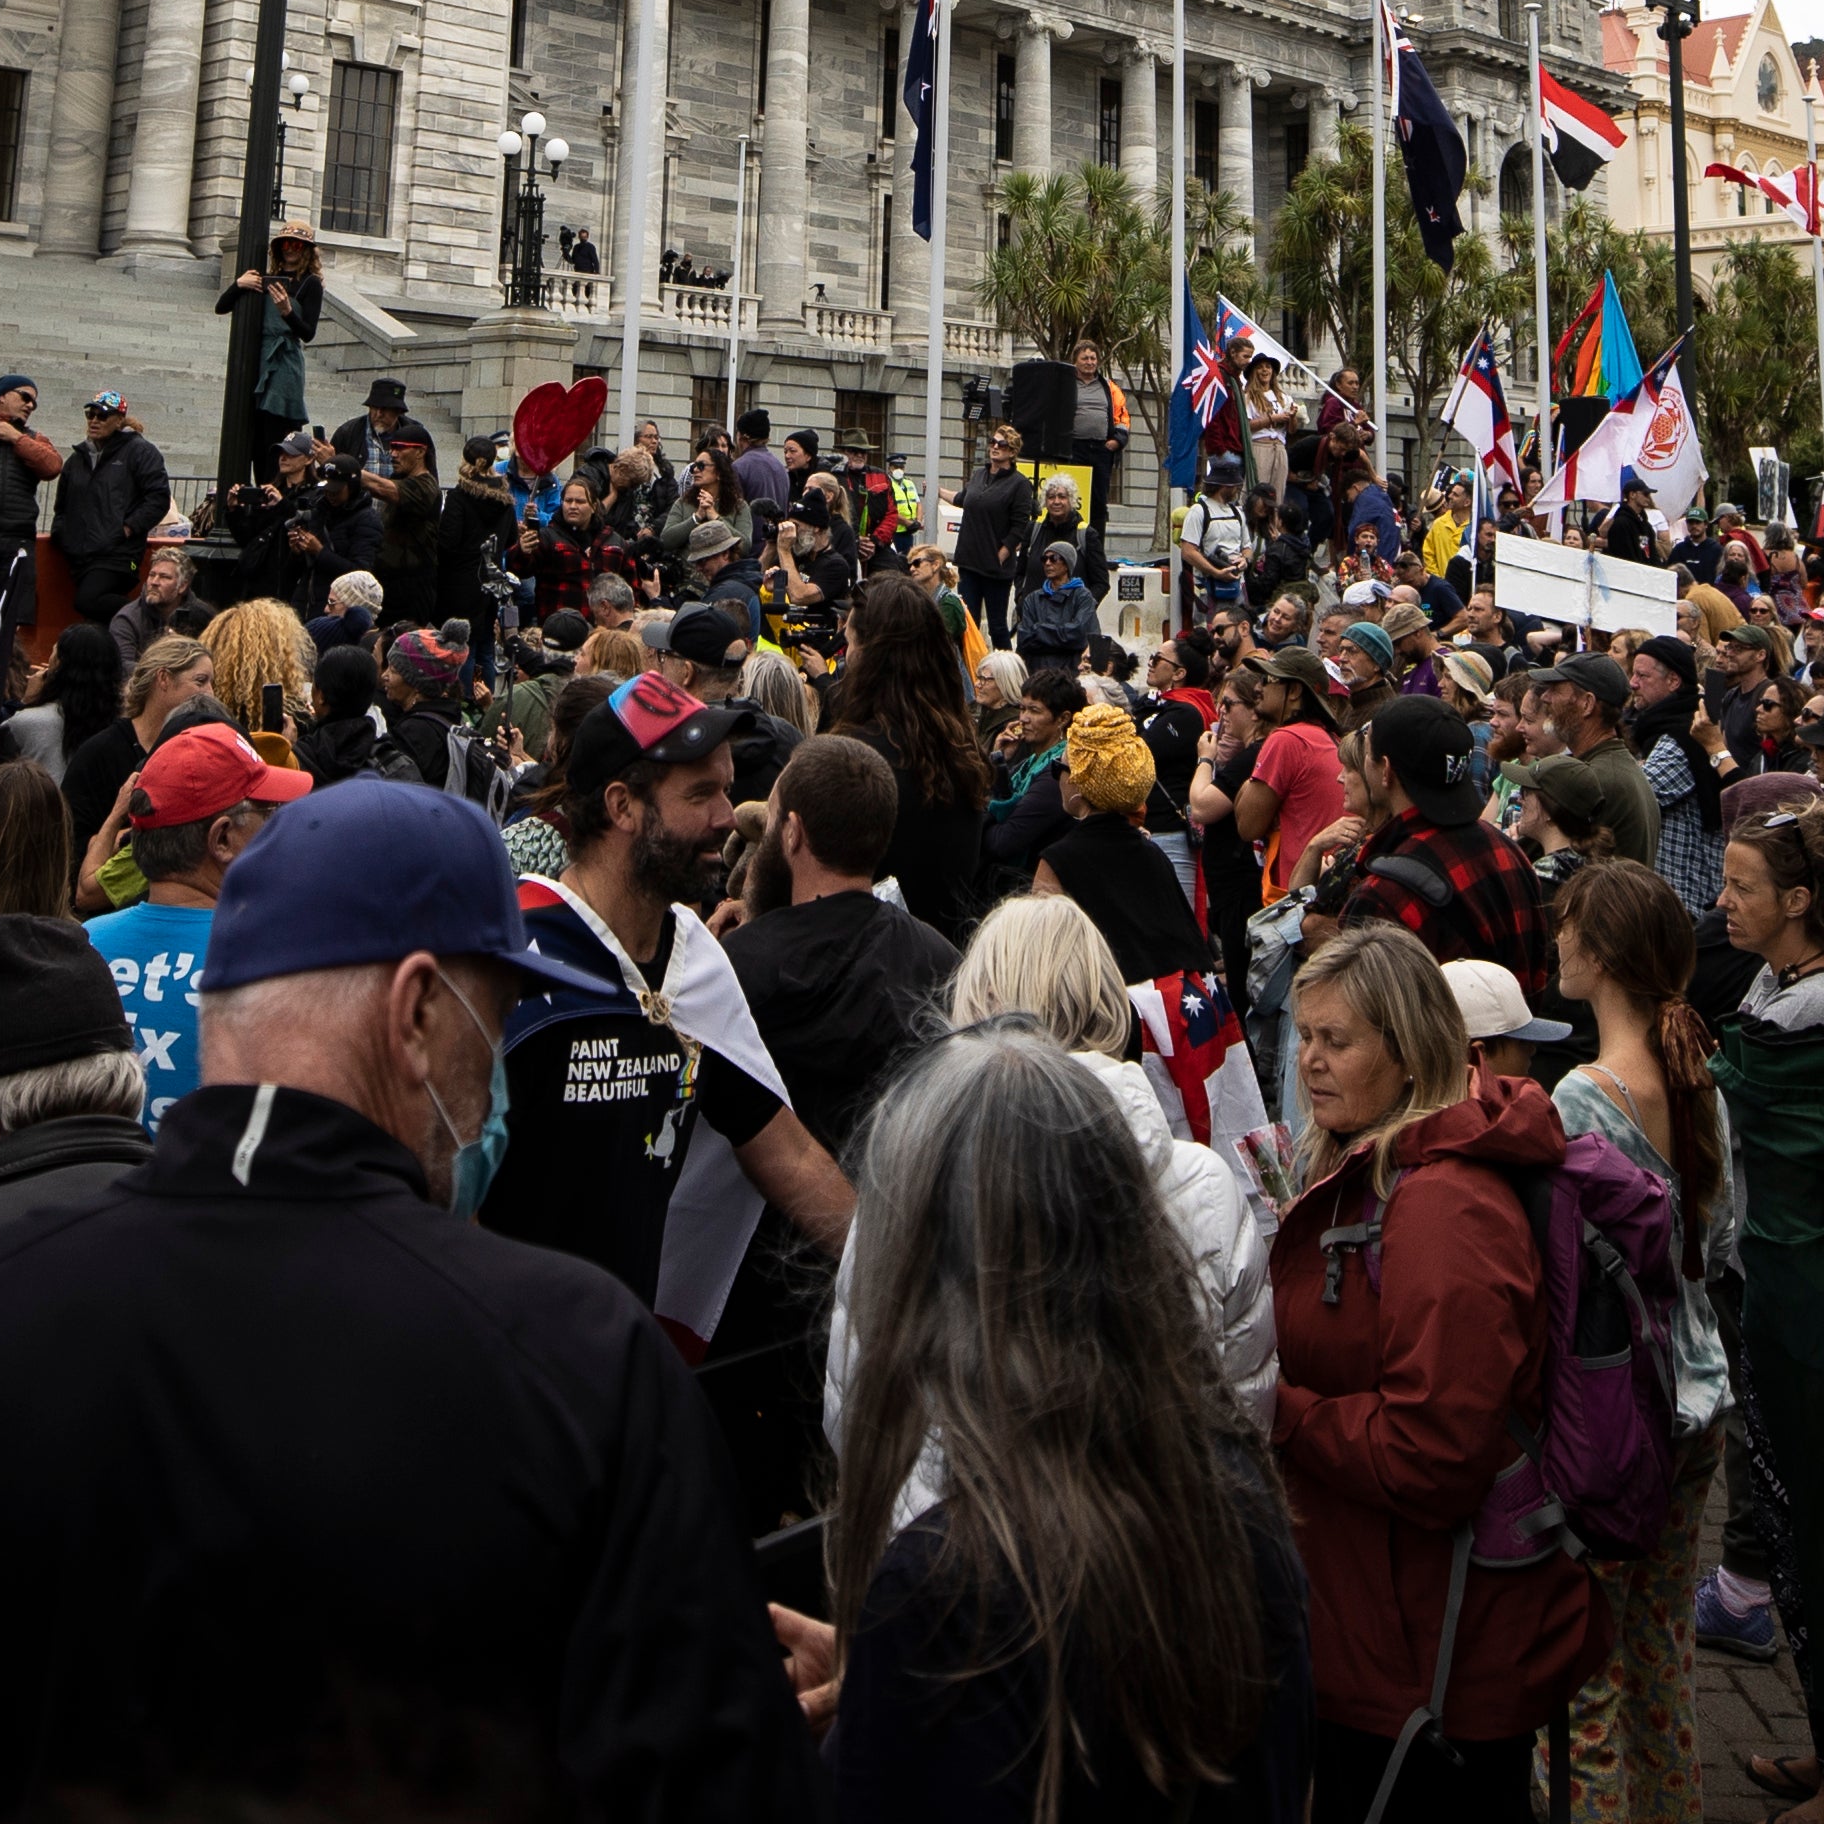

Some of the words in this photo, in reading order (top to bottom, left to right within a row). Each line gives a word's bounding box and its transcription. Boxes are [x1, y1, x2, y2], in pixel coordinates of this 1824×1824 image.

[108, 951, 205, 1007] et's
[569, 1037, 619, 1060] PAINT
[566, 1060, 612, 1081] NEW
[616, 1053, 681, 1079] ZEALAND
[563, 1078, 649, 1103] BEAUTIFUL
